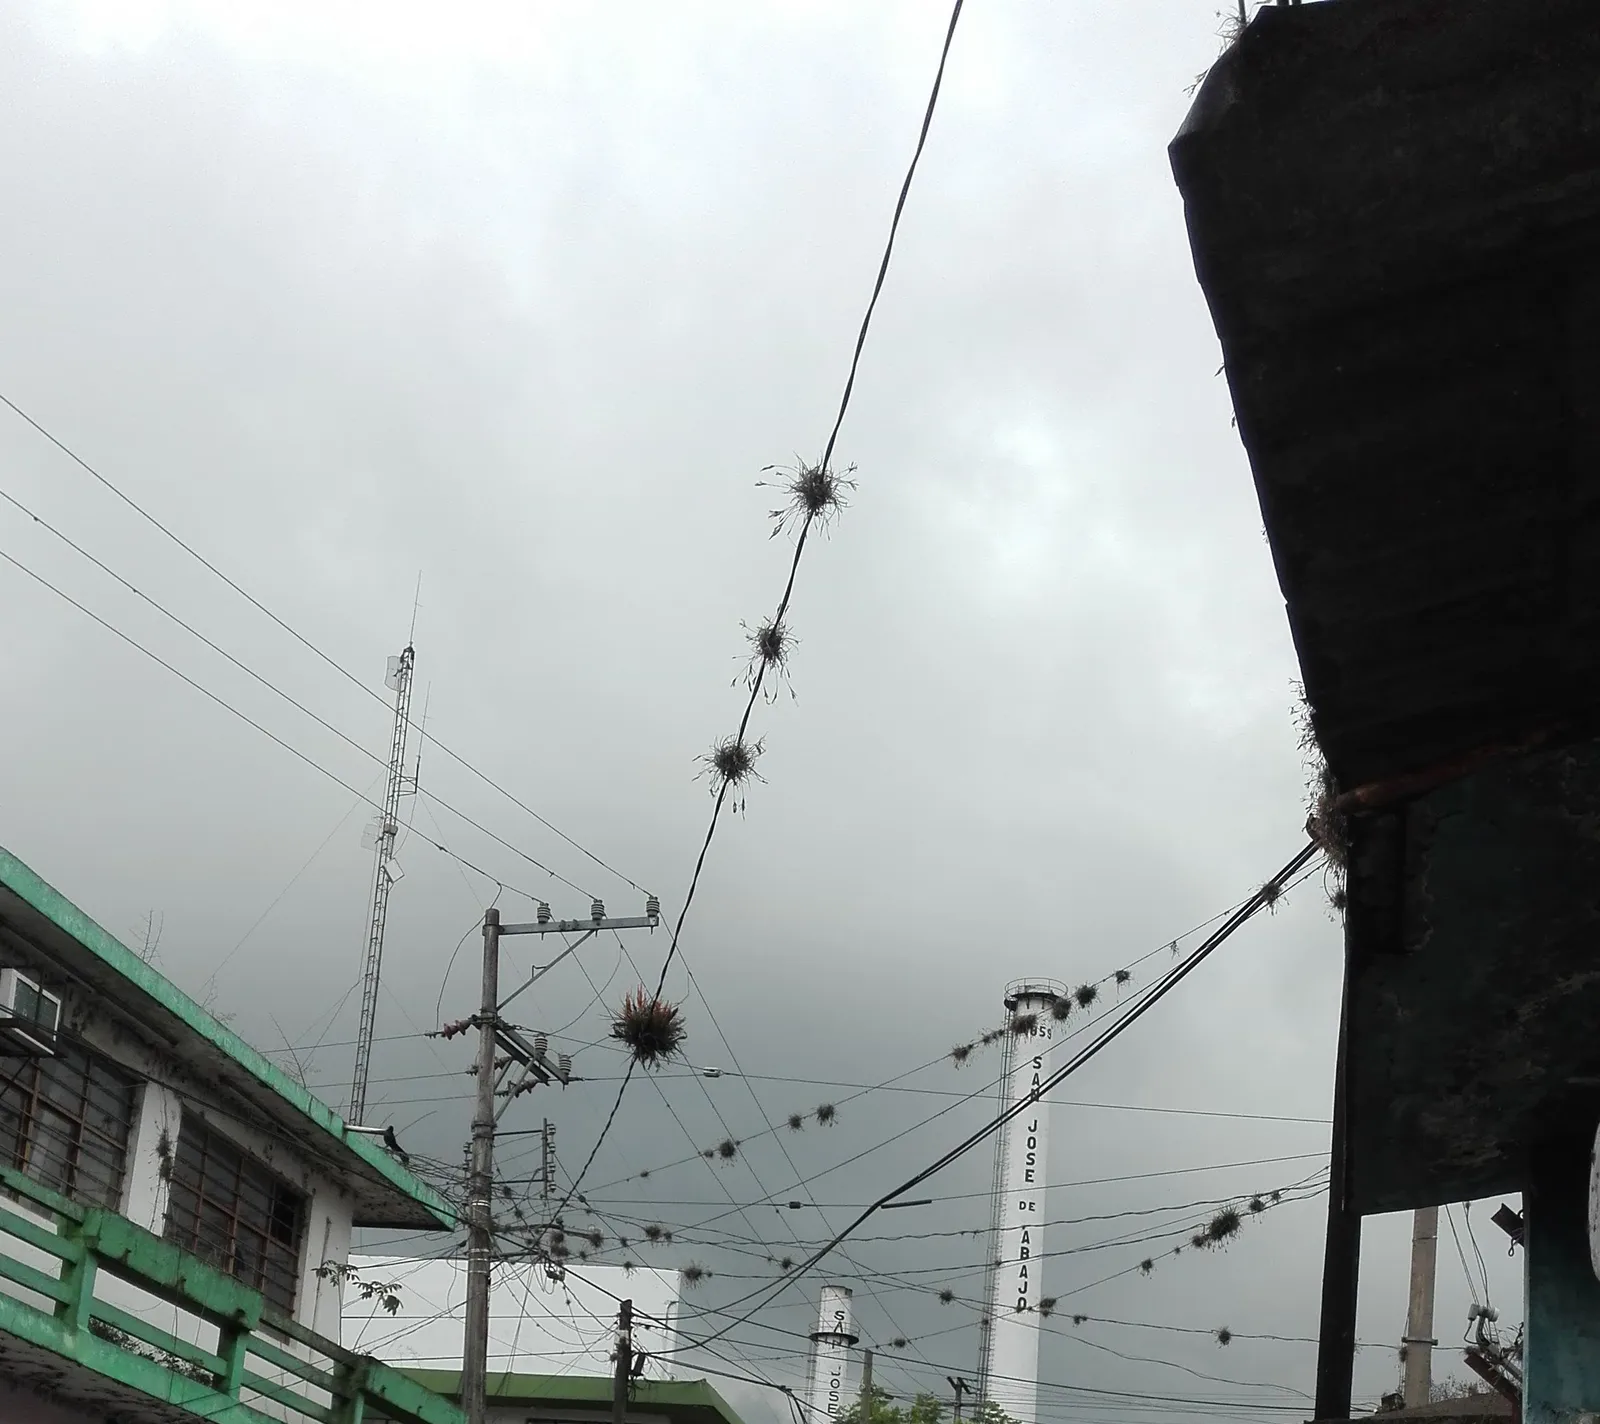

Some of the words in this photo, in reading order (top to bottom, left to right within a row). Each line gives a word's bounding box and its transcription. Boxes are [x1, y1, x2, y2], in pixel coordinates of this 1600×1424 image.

[1030, 1055, 1043, 1102] SAN
[1024, 1119, 1038, 1183] JOSE
[1019, 1201, 1036, 1212] DE
[1017, 1230, 1031, 1311] ABAJO
[827, 1366, 842, 1414] JOSE
